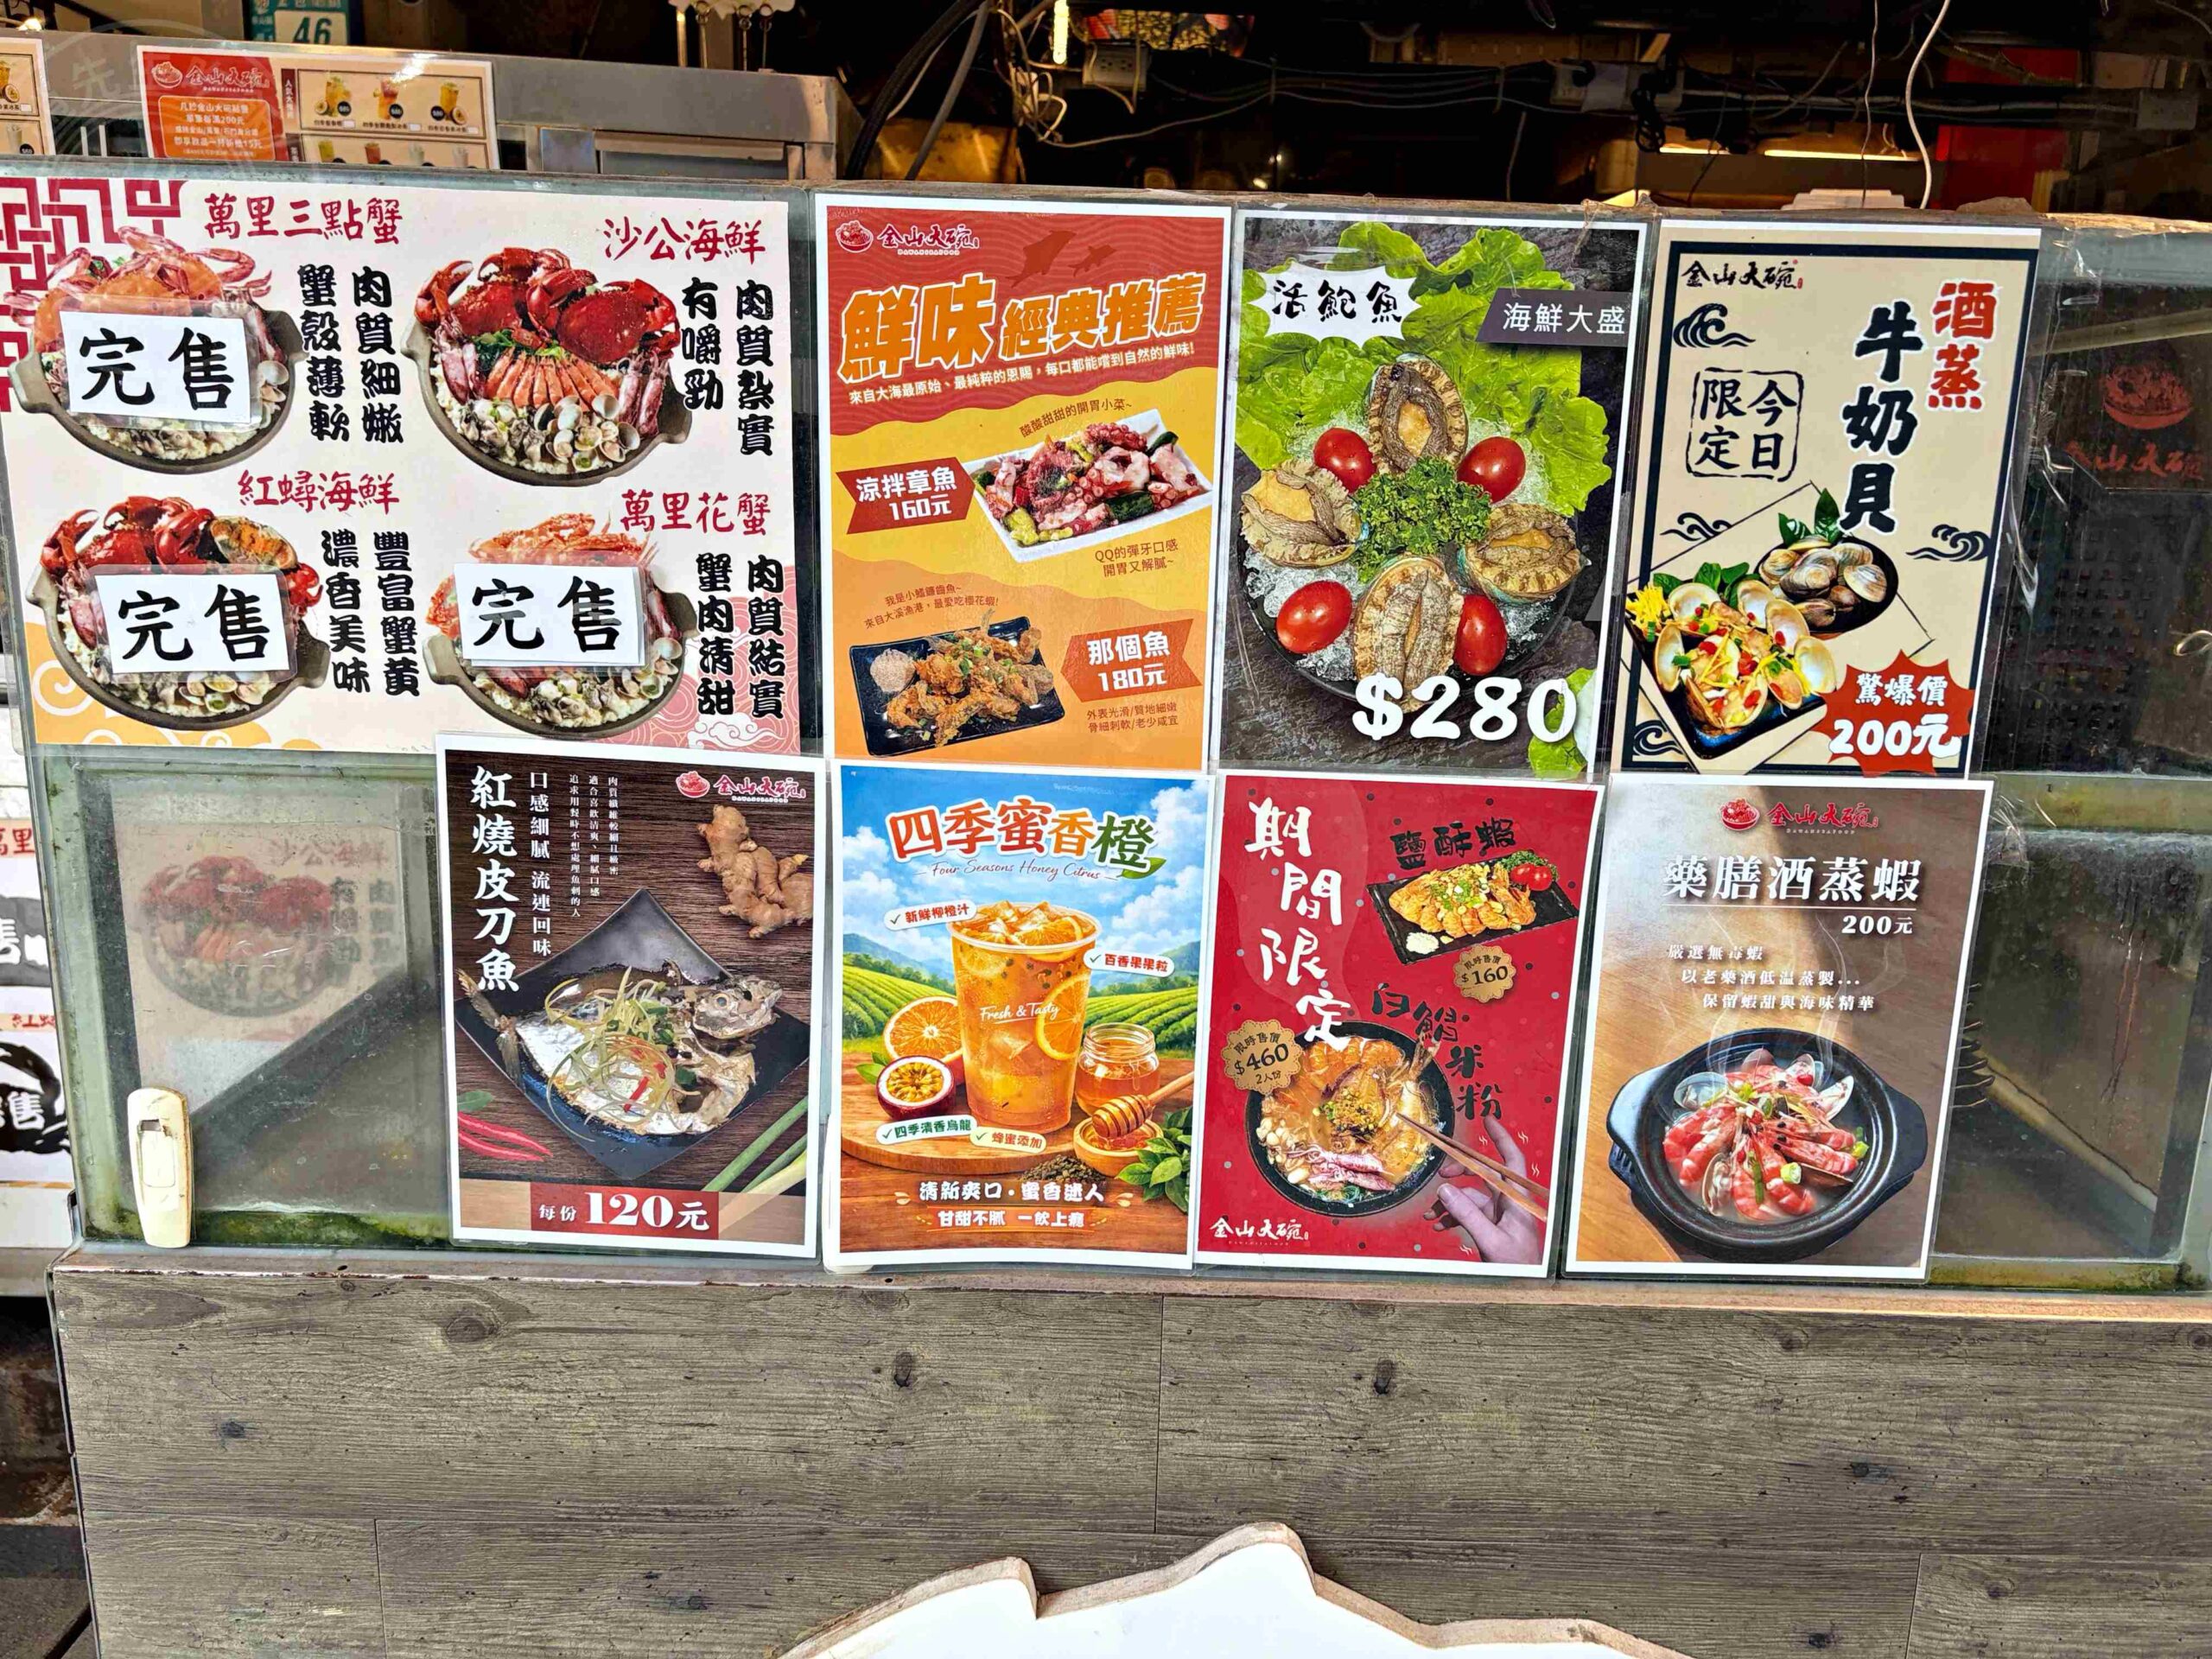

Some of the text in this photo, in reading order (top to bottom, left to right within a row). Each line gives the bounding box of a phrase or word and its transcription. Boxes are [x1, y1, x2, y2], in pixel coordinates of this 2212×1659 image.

[292, 16, 333, 44] 46
[204, 193, 404, 245] 萬里三點蟹
[603, 216, 766, 265] 沙公海鮮
[877, 223, 974, 249] 金山大碗
[1681, 259, 1796, 290] 金山大碗
[1272, 278, 1403, 325] 活鮑魚
[1502, 302, 1626, 336] 海鮮大盛
[681, 276, 724, 410] 有嚼勁
[838, 271, 1207, 385] 鮮味 經典推薦
[1929, 281, 1999, 410] 酒蒸
[79, 327, 235, 411] 完售
[297, 264, 350, 442] 蟹殼薄軟
[351, 265, 404, 444] 肉質細嫩
[735, 279, 775, 456] 肉質紮實
[1694, 379, 1740, 469] 限定
[1746, 379, 1797, 471] 今日
[1838, 300, 1923, 534] 牛奶貝
[237, 469, 401, 515] 紅蟳海鮮
[855, 466, 957, 503] 涼拌章魚
[888, 493, 952, 521] 160元
[620, 489, 771, 536] 萬里花蟹
[1094, 538, 1179, 563] QQ的彈牙口感
[118, 583, 271, 662] 完售
[321, 529, 372, 694] 濃香美味
[373, 531, 421, 697] 豐富蟹黃
[471, 575, 623, 653] 完售
[696, 552, 736, 716] 蟹肉清甜
[747, 554, 785, 720] 肉質結實
[1086, 630, 1171, 666] 那個魚
[1097, 662, 1168, 692] 180元
[1855, 672, 1948, 707] 驚爆價
[1351, 671, 1577, 744] $280
[1827, 713, 1963, 759] 200元
[713, 774, 801, 798] 金山大碗
[530, 772, 550, 859] 口感細膩
[888, 797, 1155, 869] 四季蜜香橙
[1767, 802, 1872, 829] 金山大碗
[471, 765, 519, 993] 紅燒皮刀魚
[932, 856, 1101, 882] Four Seasons Honey Citrus
[1662, 855, 1923, 902] 藥膳酒蒸蝦
[531, 870, 551, 957] 流連回味
[1244, 797, 1351, 1052] 期間限定
[1841, 915, 1914, 935] 200元
[1461, 965, 1509, 985] $160
[979, 1001, 1060, 1021] Fresh & Tasty
[1234, 1043, 1289, 1076] $460
[1255, 1070, 1282, 1084] 2人份
[991, 1132, 1043, 1149] 蜂蜜添加
[538, 1192, 711, 1231] 每份 120元
[938, 1210, 1007, 1228] 甘甜不膩
[1210, 1217, 1303, 1241] 金山大碗
